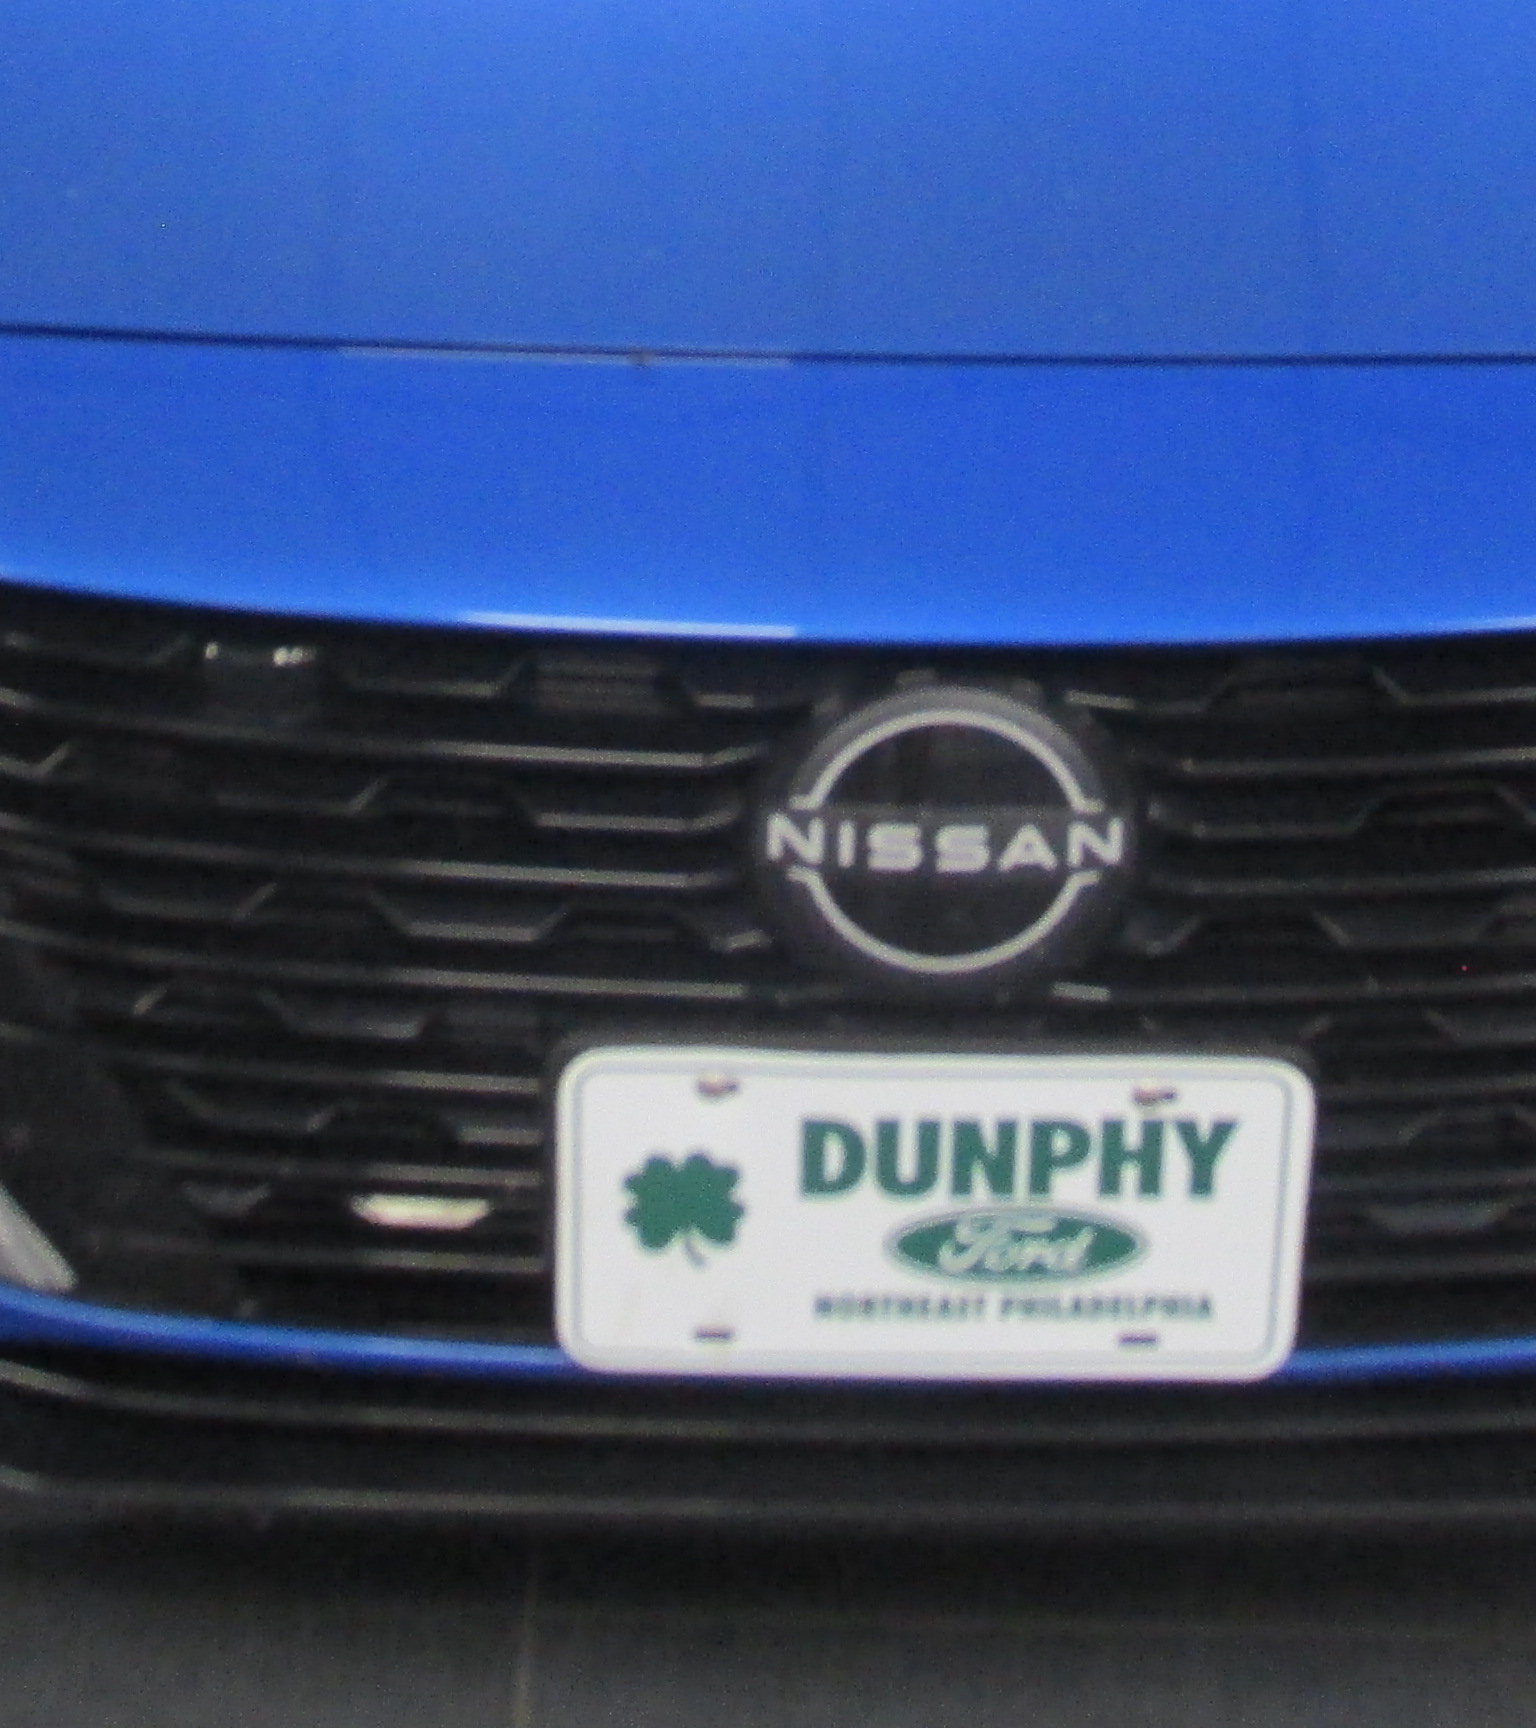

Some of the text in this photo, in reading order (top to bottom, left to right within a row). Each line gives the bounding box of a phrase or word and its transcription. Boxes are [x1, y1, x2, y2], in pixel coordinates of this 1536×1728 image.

[766, 812, 1126, 873] NISSAN
[798, 1114, 1239, 1202] DUNPHY
[937, 1212, 1099, 1273] Ford
[813, 1292, 1213, 1325] NORTHEAST PHILADELPHIA
